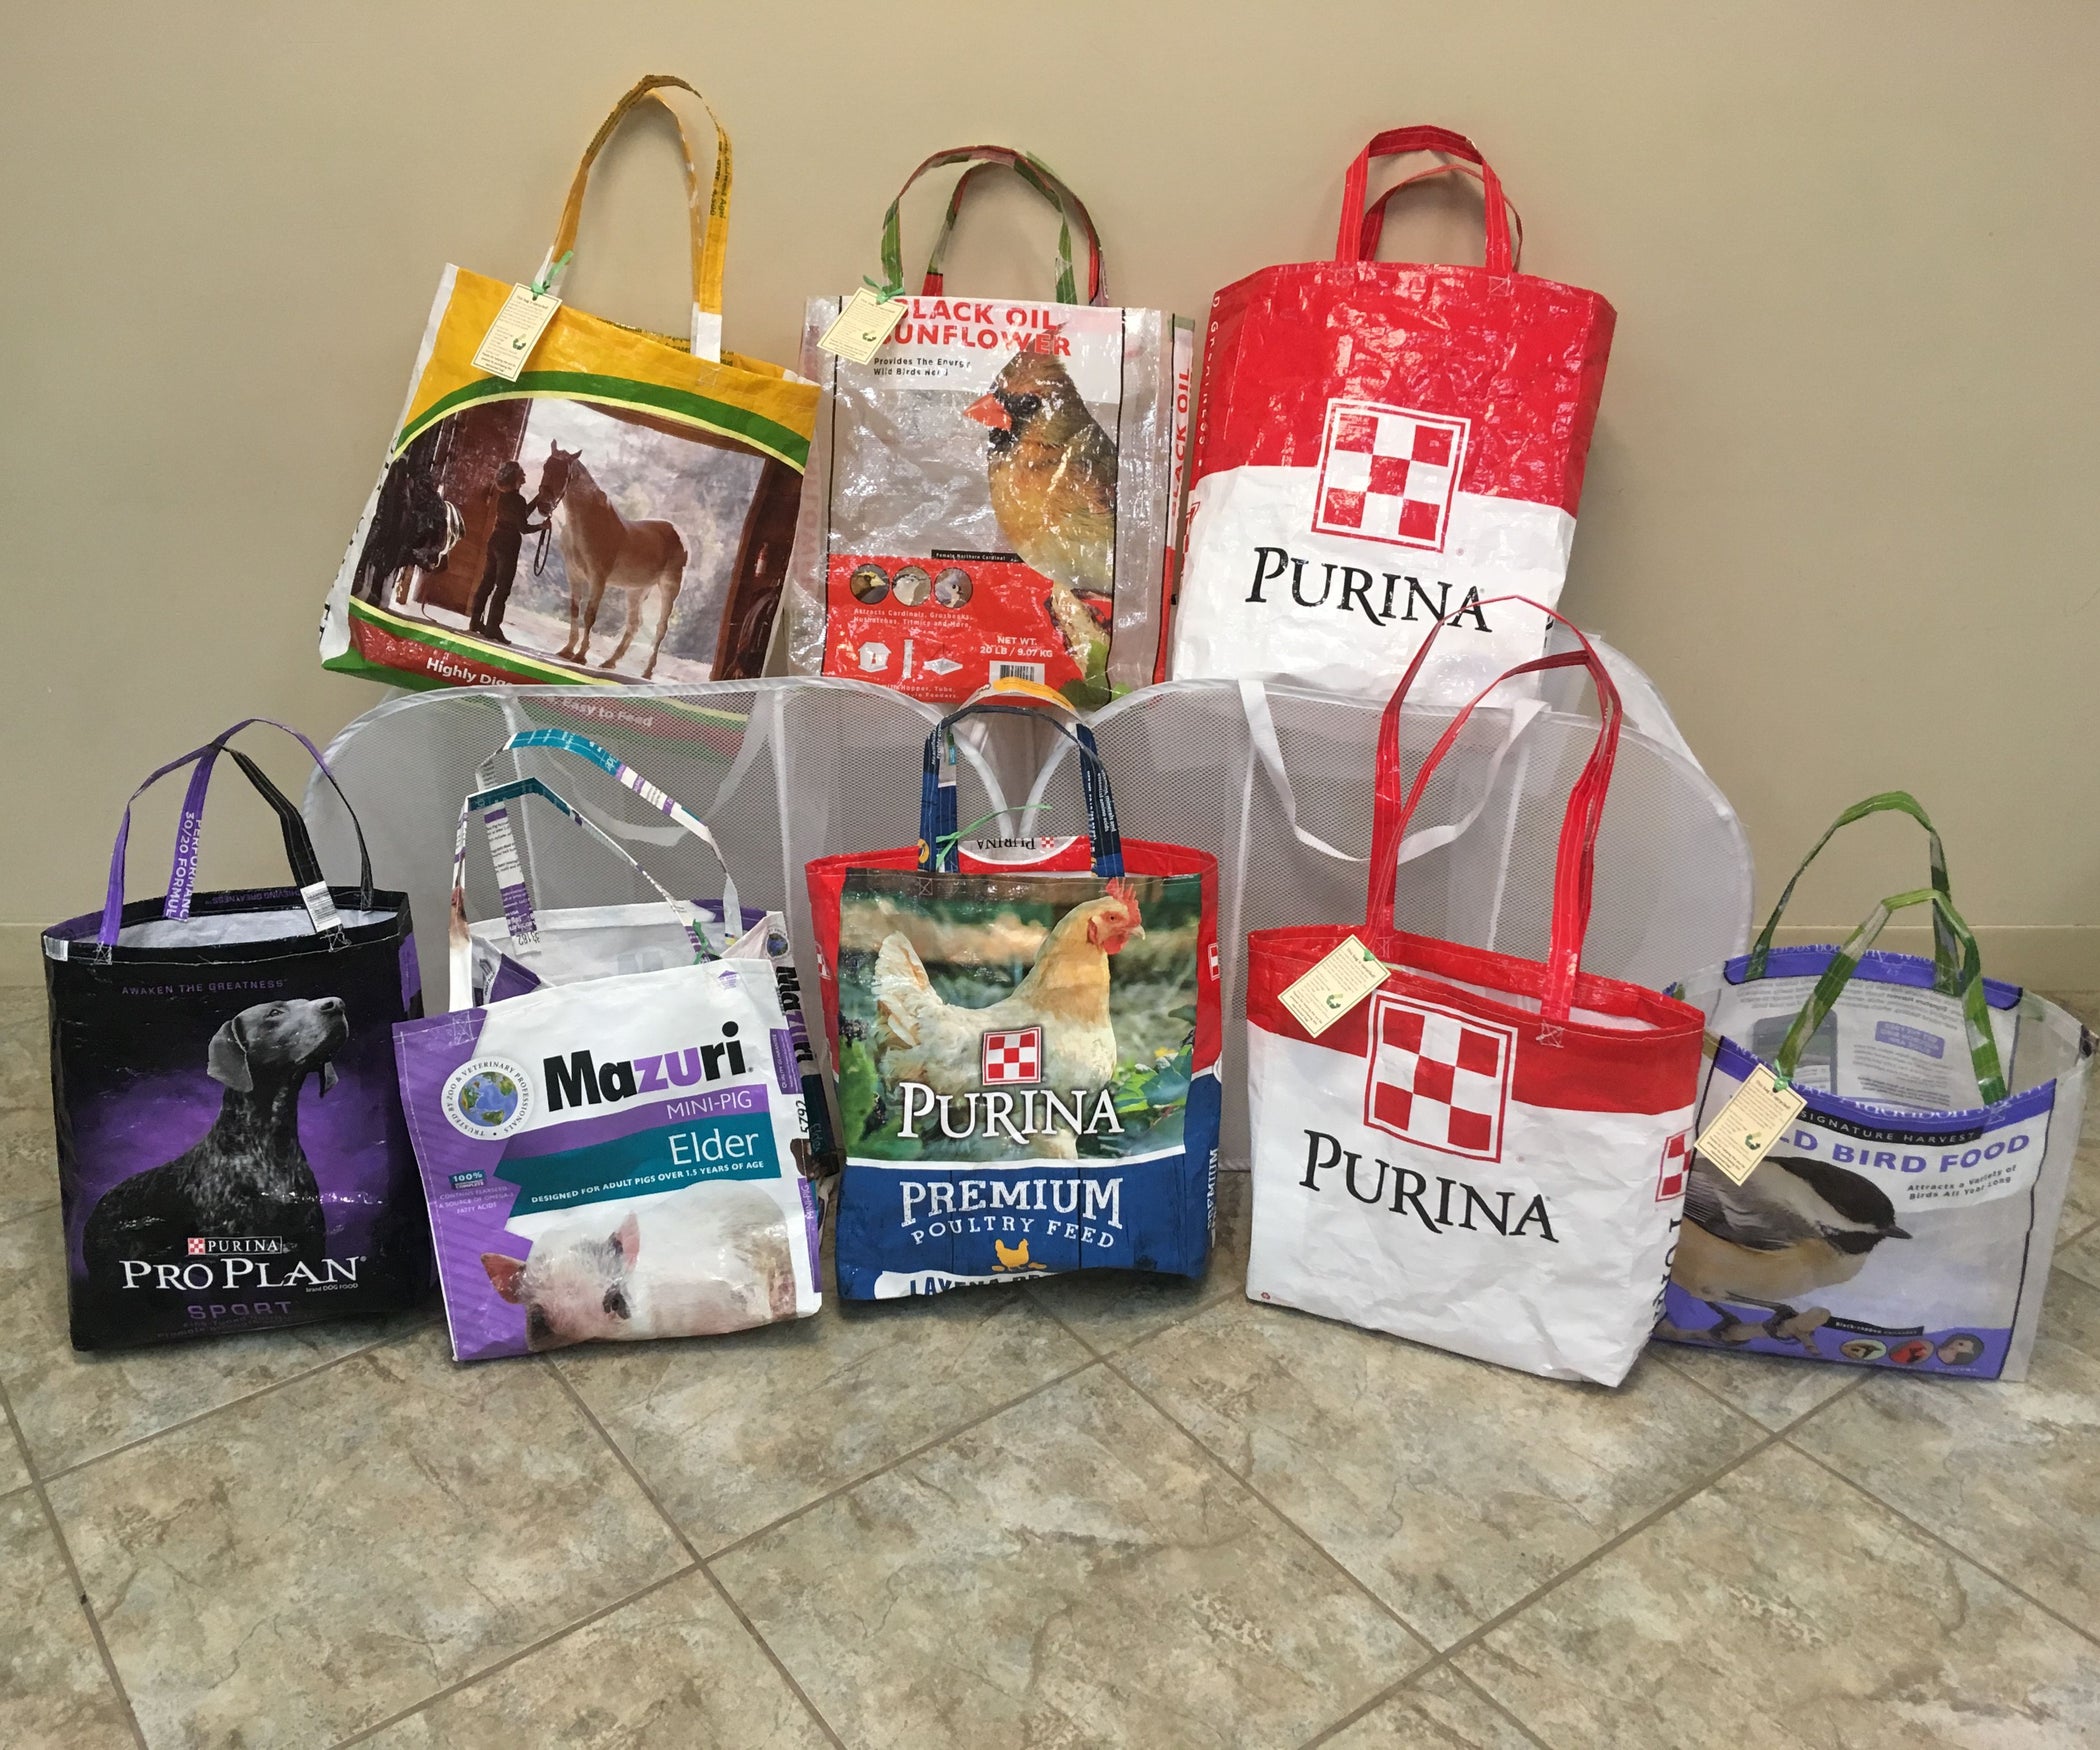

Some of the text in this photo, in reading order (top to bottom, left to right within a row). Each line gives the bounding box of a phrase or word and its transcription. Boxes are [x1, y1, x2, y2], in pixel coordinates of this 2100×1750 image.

[1006, 307, 1059, 331] OIL
[883, 324, 1071, 356] UNFLOWER
[873, 357, 913, 366] Provides
[917, 358, 934, 366] The
[1176, 367, 1191, 414] OIL
[1244, 546, 1493, 633] PURINA
[979, 645, 993, 655] 20
[994, 646, 1008, 655] LB
[1017, 647, 1039, 657] 9.07
[1039, 648, 1053, 658] KG
[997, 635, 1038, 646] NET WT.
[426, 656, 478, 684] Highly
[599, 705, 615, 719] to
[179, 810, 195, 854] 30/20
[121, 985, 174, 996] AWAKEN
[178, 983, 204, 993] THE
[543, 1020, 747, 1113] Mazuri
[446, 1060, 530, 1137] TRUSTED BY ZOO & VETERINARY PROFESSIONALS
[667, 1090, 752, 1120] MINI-PIG
[897, 1082, 1125, 1145] PURINA
[1801, 1109, 1894, 1142] SIGNATURE
[1903, 1130, 1978, 1144] HARVEST
[668, 1128, 759, 1166] Elder
[1832, 1133, 2030, 1174] BIRD FOOD
[452, 1171, 483, 1183] 100%
[531, 1160, 765, 1204] DESIGNED FOR ADULT PIGS OVER 1.5 YEARS OF AGE
[1298, 1129, 1560, 1244] PURINA
[1907, 1183, 1955, 1191] Attracts
[1968, 1169, 2003, 1185] Variety
[2005, 1164, 2017, 1174] of
[1908, 1191, 1939, 1200] Birds
[1964, 1184, 1985, 1195] Year
[445, 1199, 472, 1208] SOURCE
[899, 1177, 1124, 1230] PREMIUM
[207, 1239, 280, 1252] PURINA
[910, 1215, 1115, 1249] POULTRY FEED
[118, 1255, 361, 1291] PRO PLAN
[339, 1282, 359, 1290] FOOD
[187, 1301, 292, 1320] SPORT
